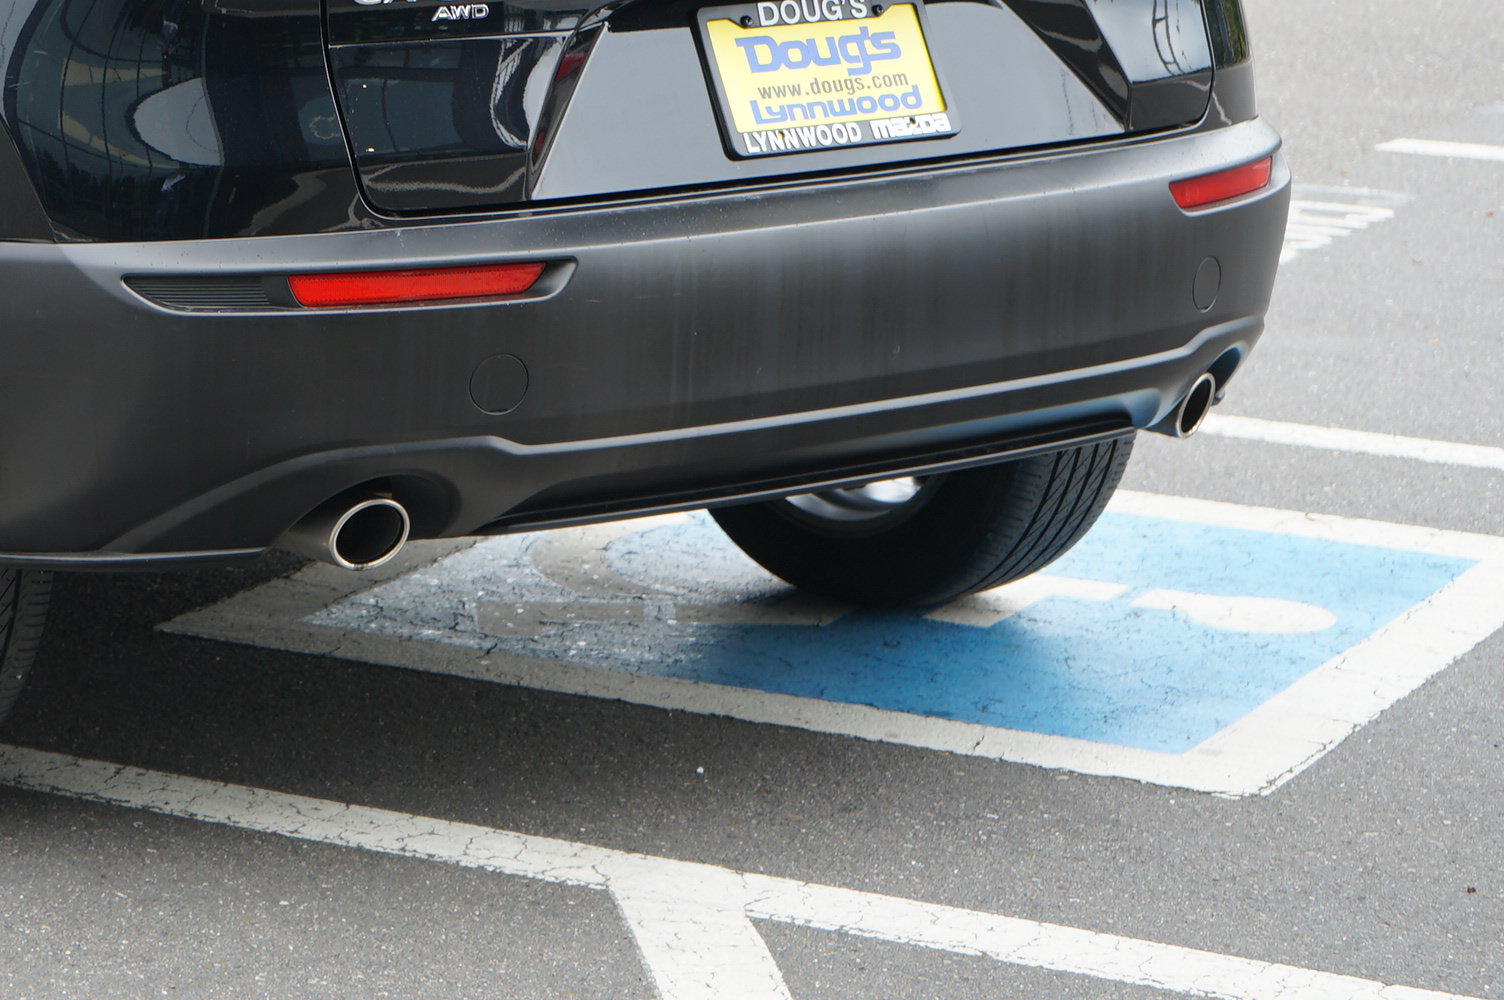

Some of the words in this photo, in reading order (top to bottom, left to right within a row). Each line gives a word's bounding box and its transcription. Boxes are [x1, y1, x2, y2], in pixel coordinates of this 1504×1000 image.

[431, 4, 490, 22] AWD
[734, 26, 902, 76] Doug's
[757, 73, 909, 100] www.dougs.com
[749, 85, 923, 125] Lynnwood
[743, 121, 862, 154] LYNNWOOD
